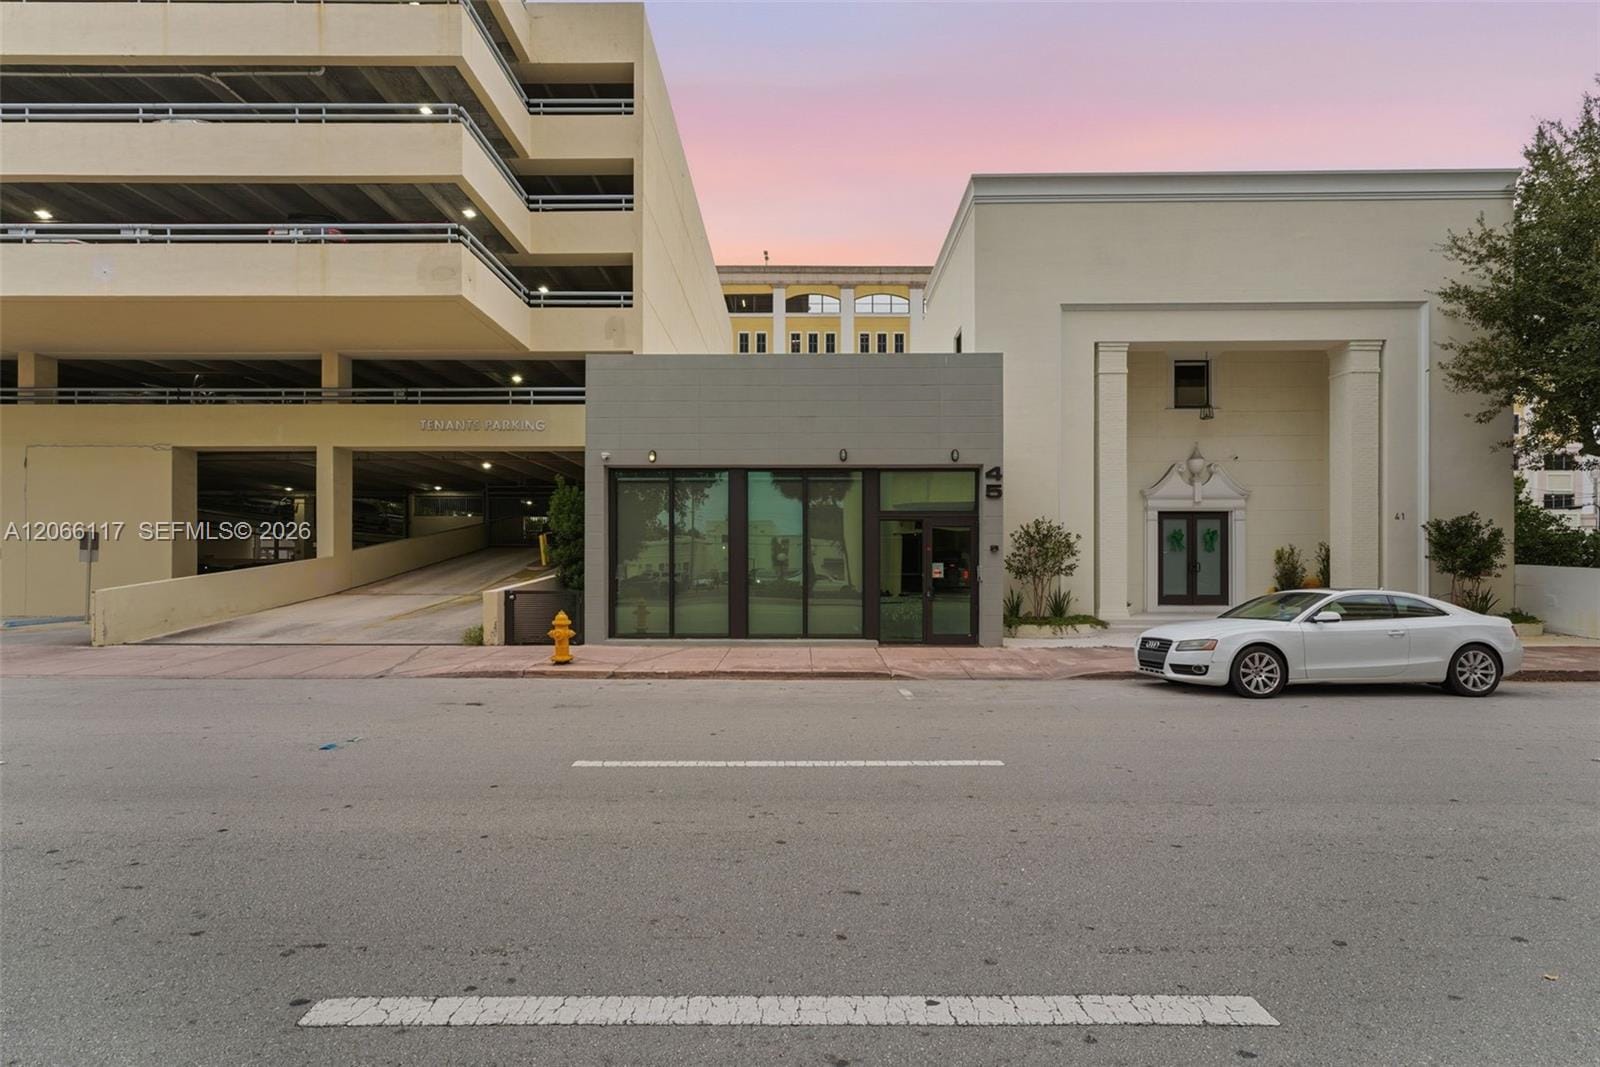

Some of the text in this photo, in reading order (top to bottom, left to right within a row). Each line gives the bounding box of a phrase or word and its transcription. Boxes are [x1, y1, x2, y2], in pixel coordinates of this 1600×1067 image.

[420, 419, 546, 431] TENANTS PARKING
[1394, 512, 1405, 521] 41
